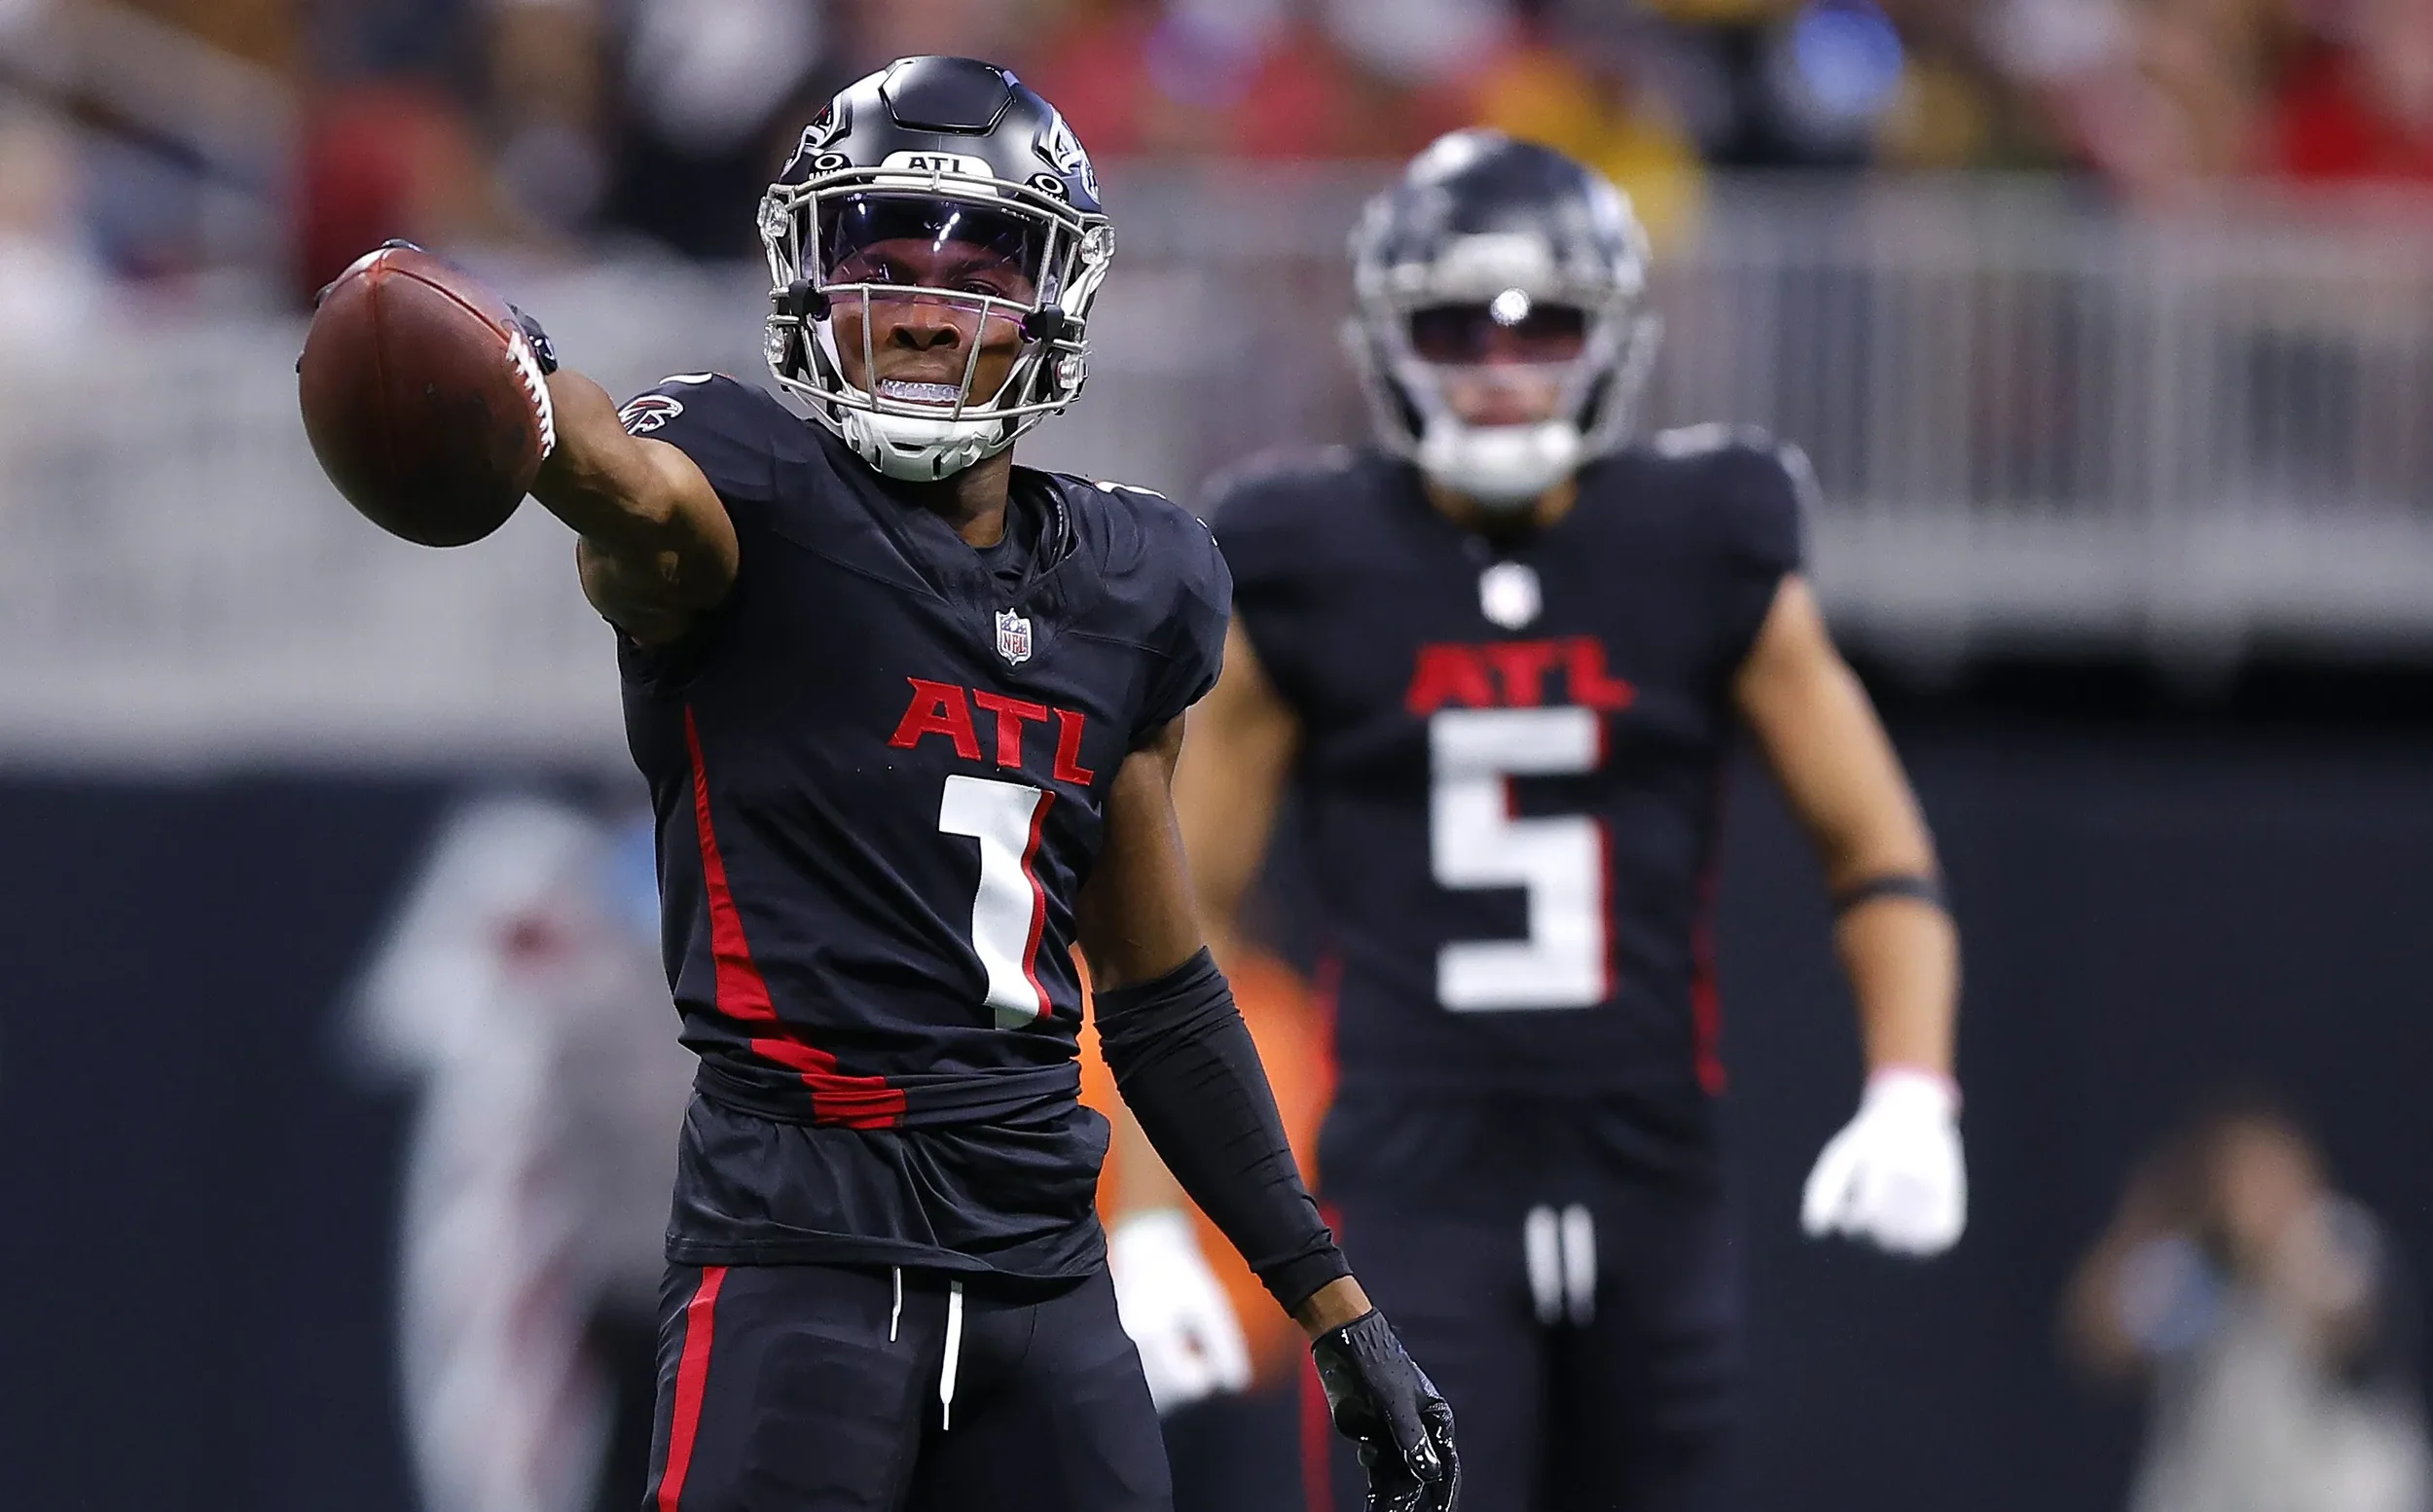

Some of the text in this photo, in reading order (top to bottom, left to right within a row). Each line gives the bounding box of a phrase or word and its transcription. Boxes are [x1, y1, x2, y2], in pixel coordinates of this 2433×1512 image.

[908, 157, 966, 174] ATL
[1002, 631, 1027, 654] NFL
[1404, 634, 1638, 716] ATL
[887, 676, 1095, 786] ATL
[938, 774, 1056, 1030] 1
[1428, 704, 1616, 1013] 5
